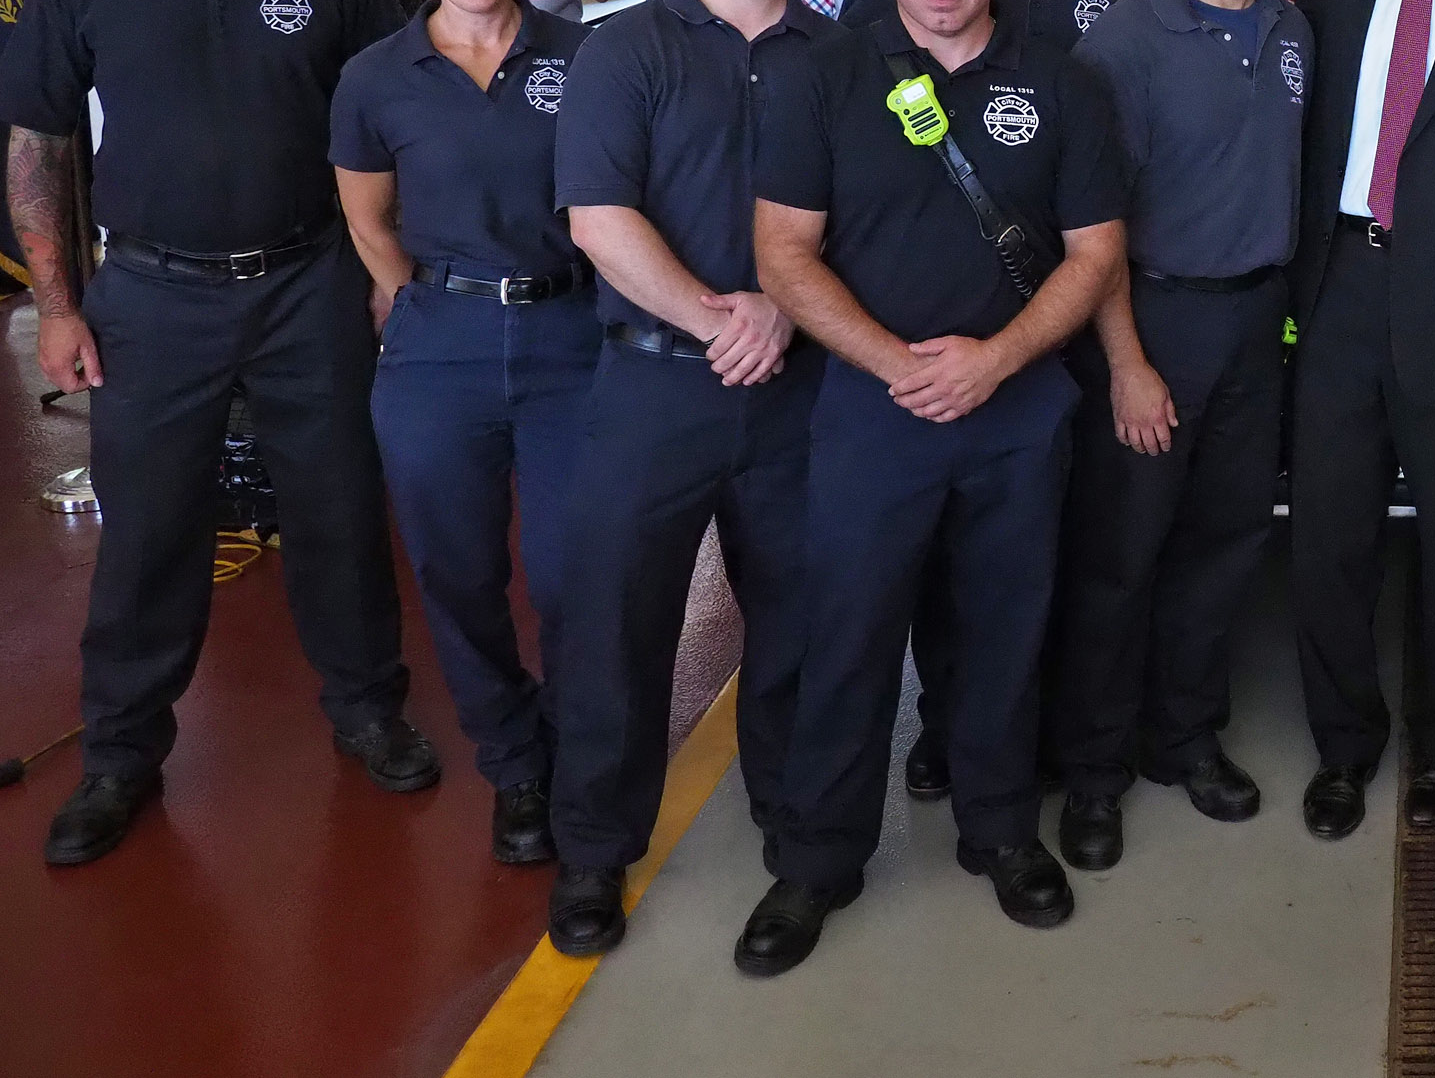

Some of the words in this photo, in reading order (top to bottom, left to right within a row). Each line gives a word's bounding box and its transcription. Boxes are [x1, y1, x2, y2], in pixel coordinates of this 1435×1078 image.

[263, 6, 310, 14] PORTSMOUTH
[989, 84, 1016, 93] LOCAL
[987, 115, 1036, 125] PORTSMOUTH
[1002, 133, 1020, 141] FIRE
